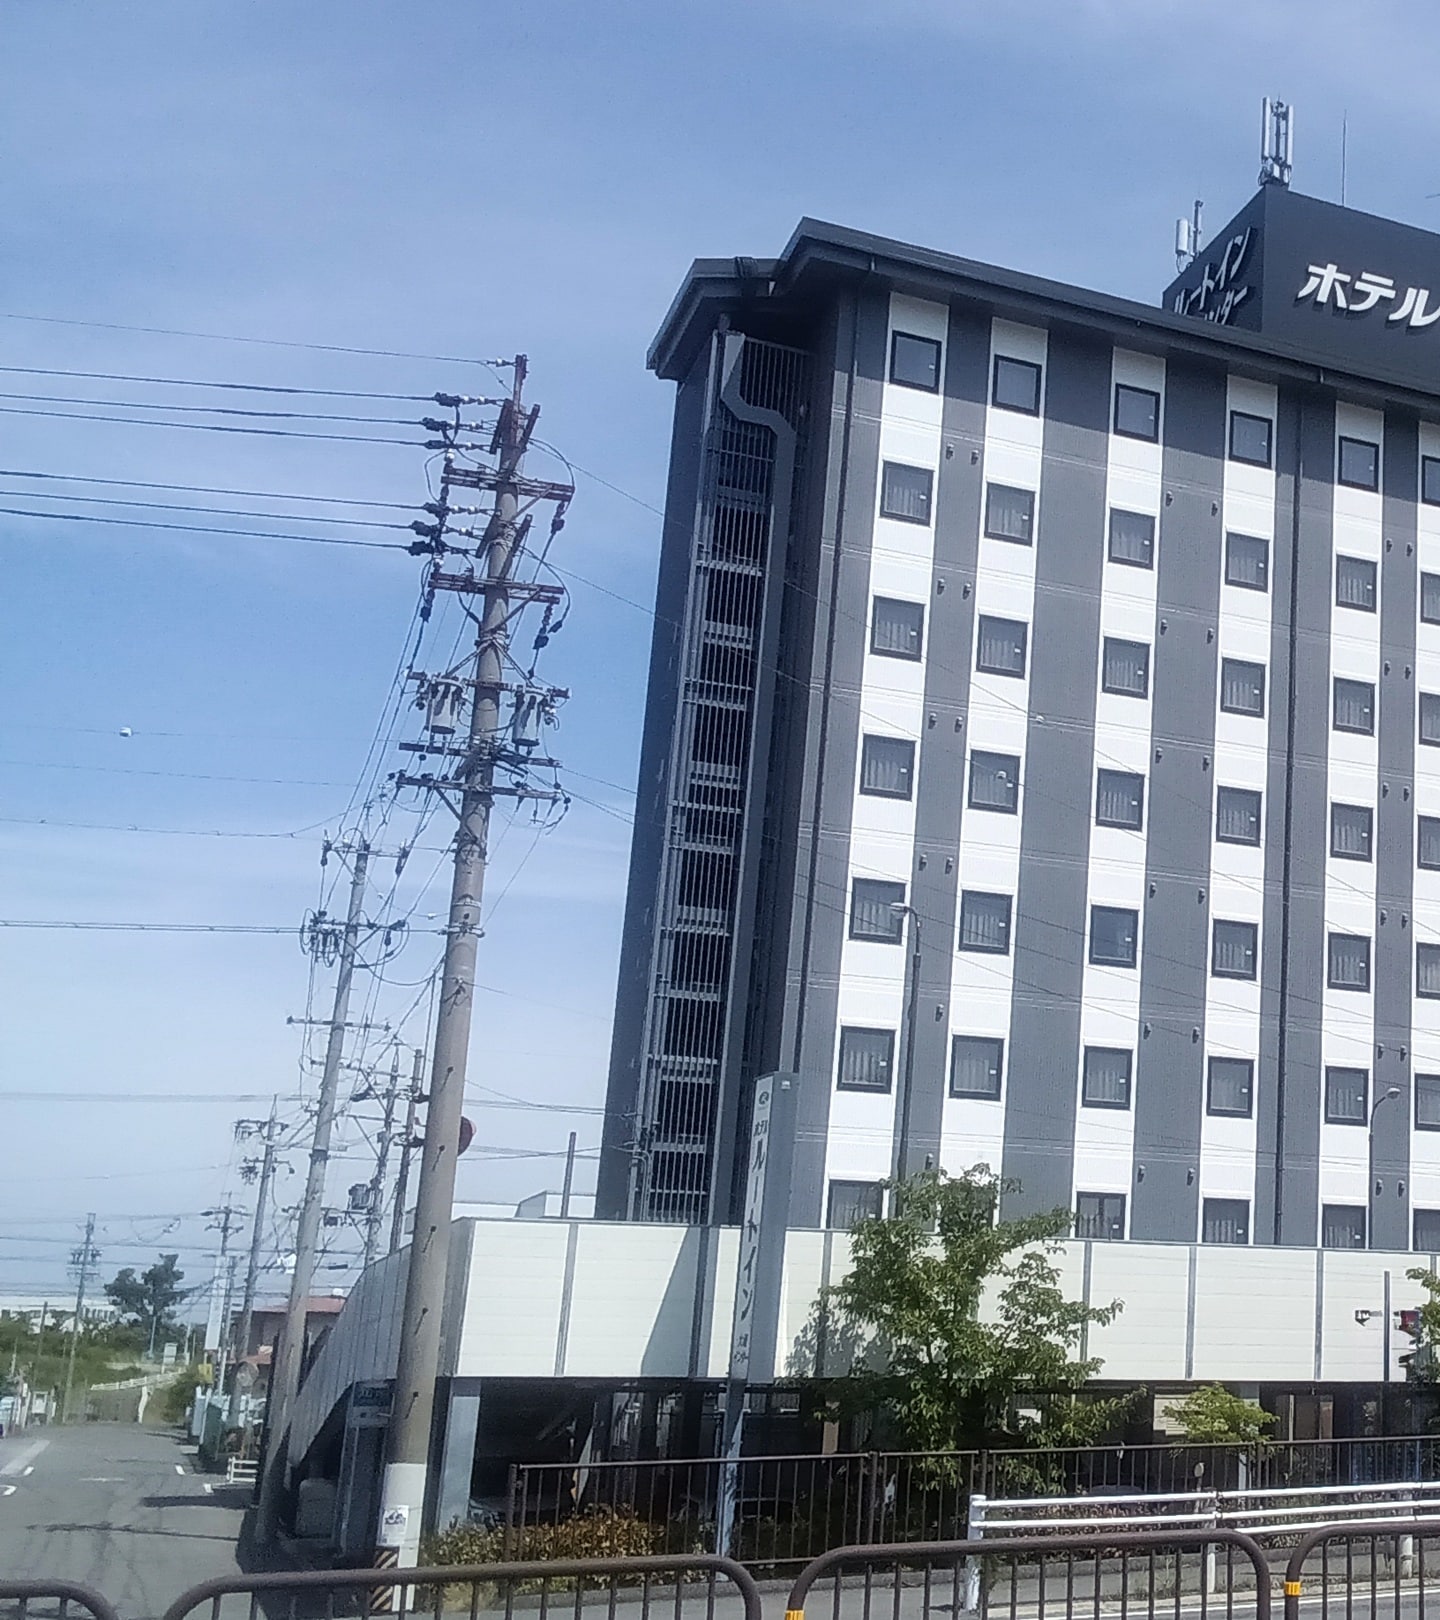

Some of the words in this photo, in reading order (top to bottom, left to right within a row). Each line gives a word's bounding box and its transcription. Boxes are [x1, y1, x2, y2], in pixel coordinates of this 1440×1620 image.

[740, 1138, 767, 1321] ルートイン
